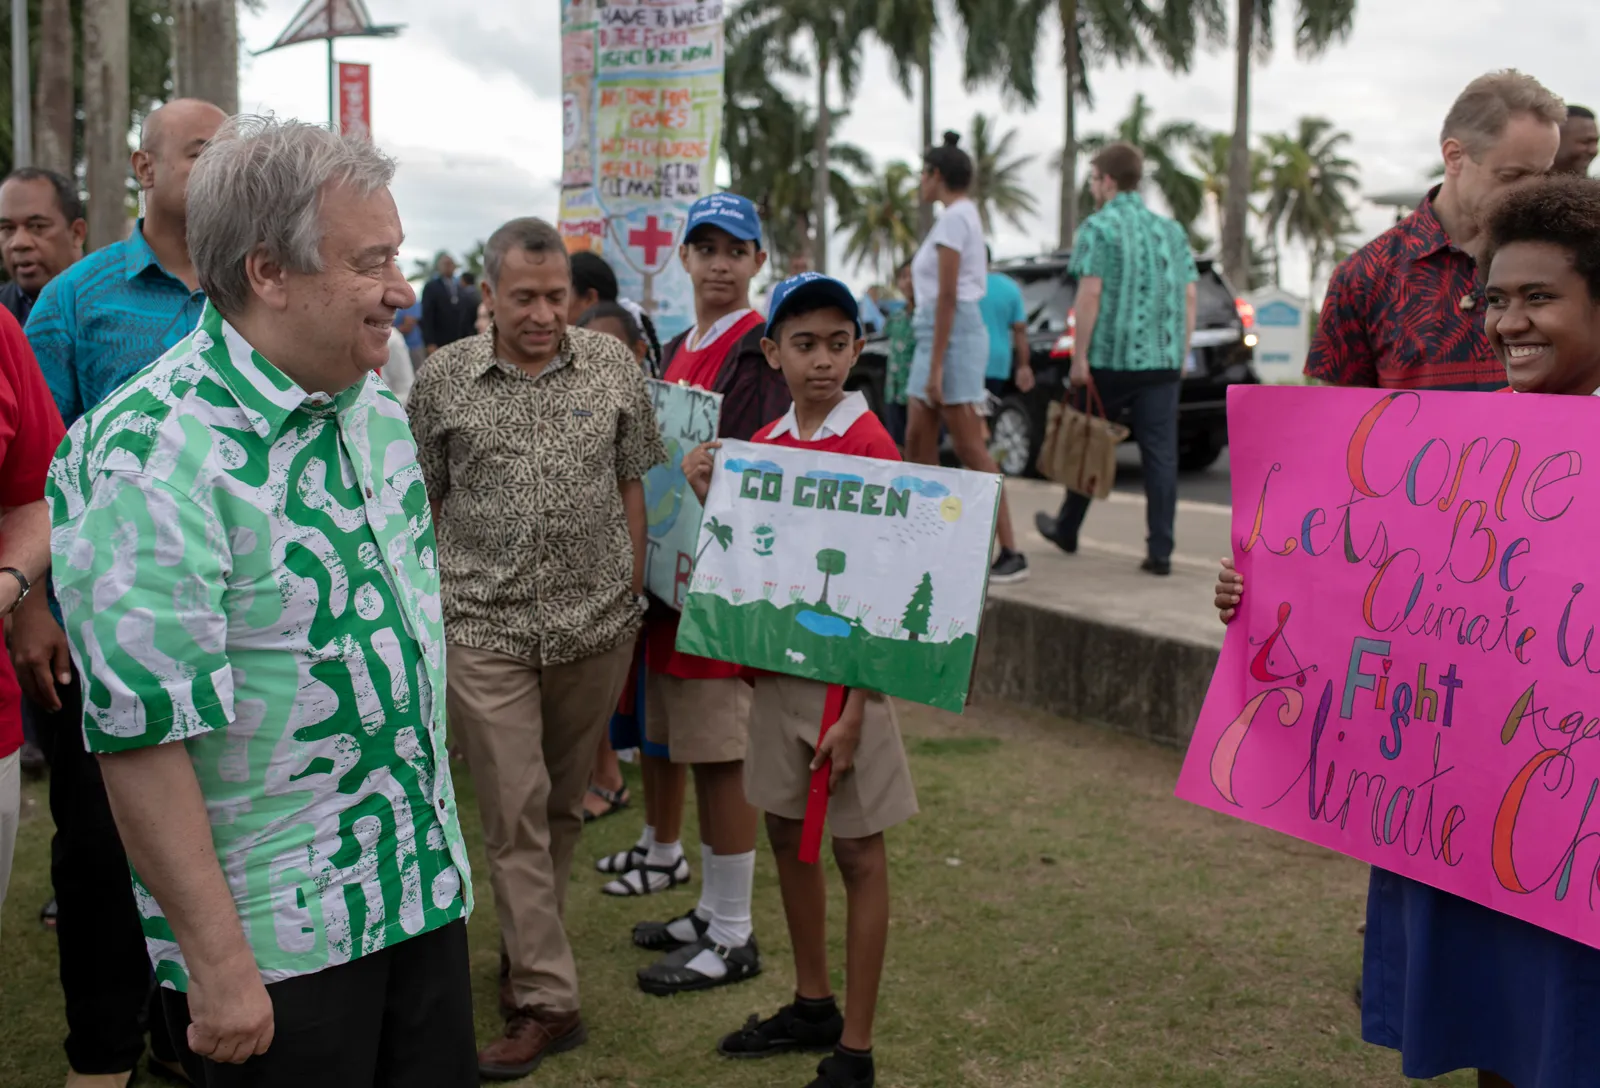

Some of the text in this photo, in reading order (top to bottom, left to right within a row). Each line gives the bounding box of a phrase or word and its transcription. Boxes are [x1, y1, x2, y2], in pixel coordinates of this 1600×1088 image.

[600, 8, 647, 26] HAVE
[629, 108, 689, 129] GAMES
[600, 176, 674, 199] CLIMATE
[739, 467, 912, 520] GO GREEN
[1346, 390, 1583, 522] Come
[1435, 498, 1532, 592] Be
[1362, 547, 1538, 665] Climate
[1339, 635, 1464, 761] Fight
[1209, 685, 1467, 867] Climate
